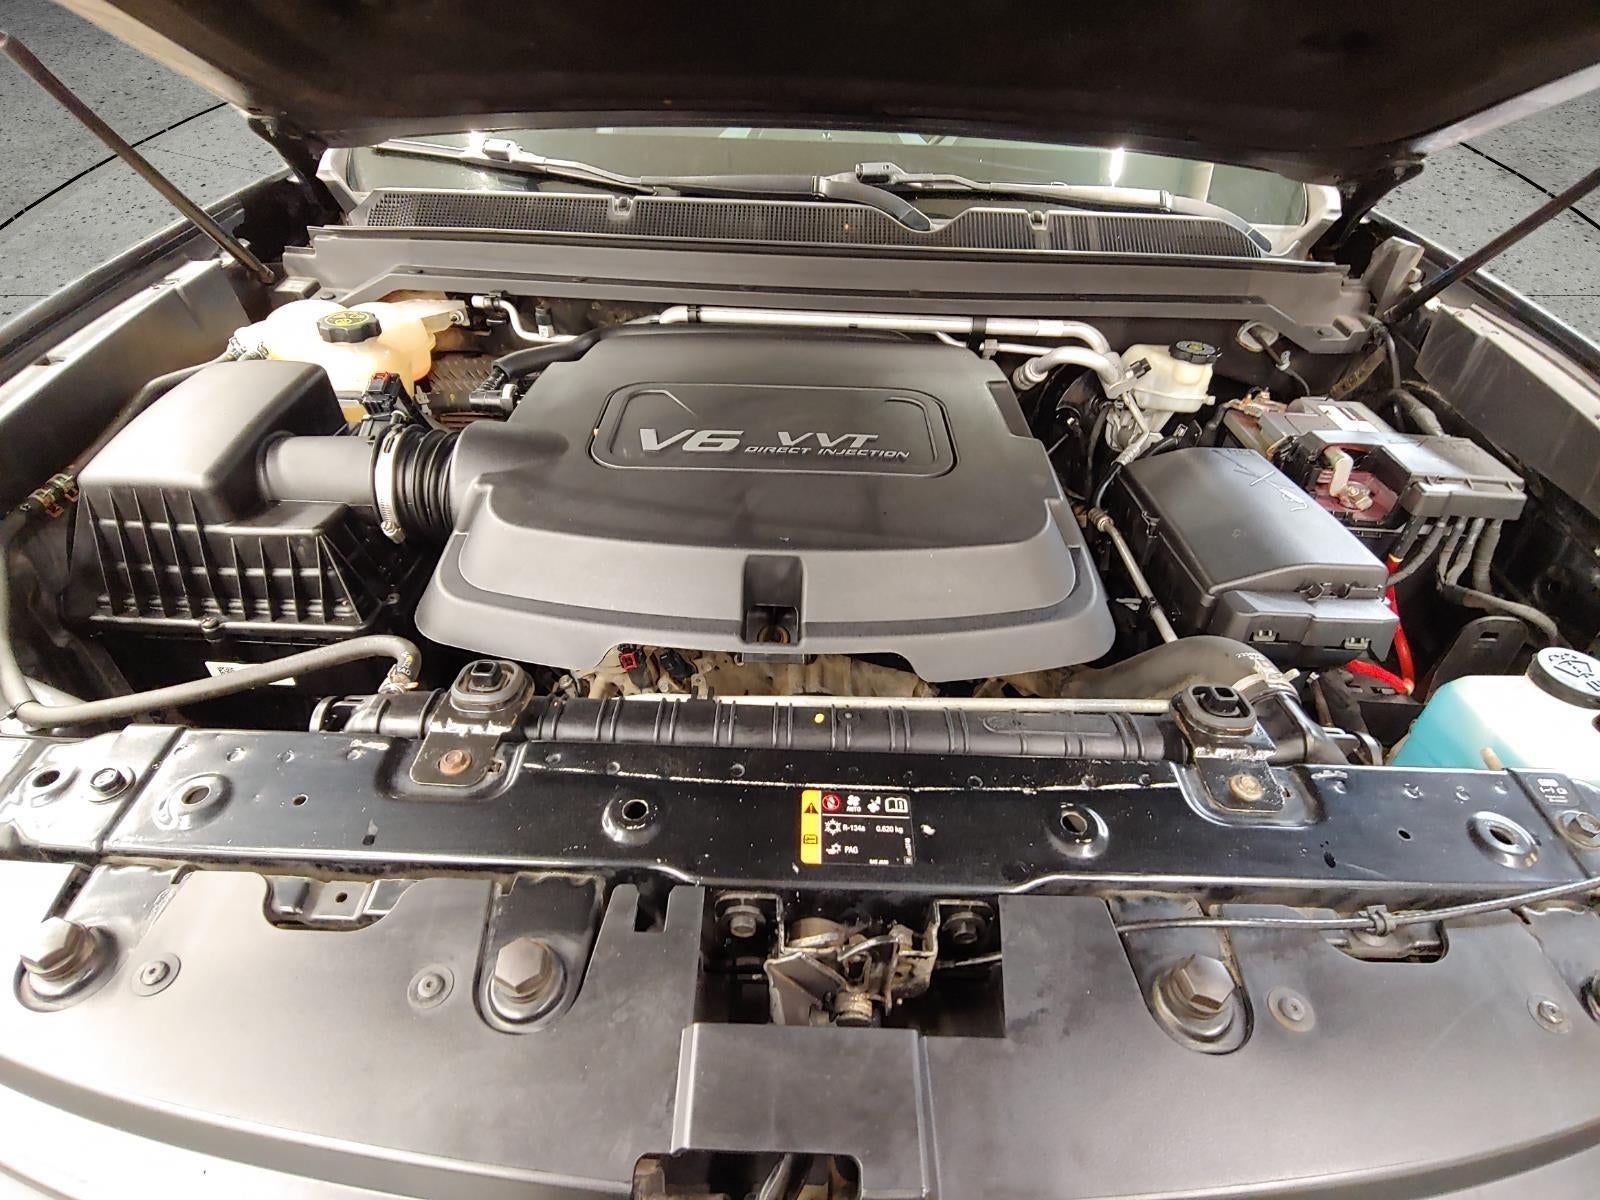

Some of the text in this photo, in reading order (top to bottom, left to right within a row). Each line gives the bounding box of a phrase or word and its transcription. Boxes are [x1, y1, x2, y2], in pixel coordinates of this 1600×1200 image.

[639, 428, 880, 452] V6 VVT
[744, 446, 911, 458] DIRECT INJECTION
[842, 823, 866, 832] R-134a
[844, 845, 859, 854] PAG
